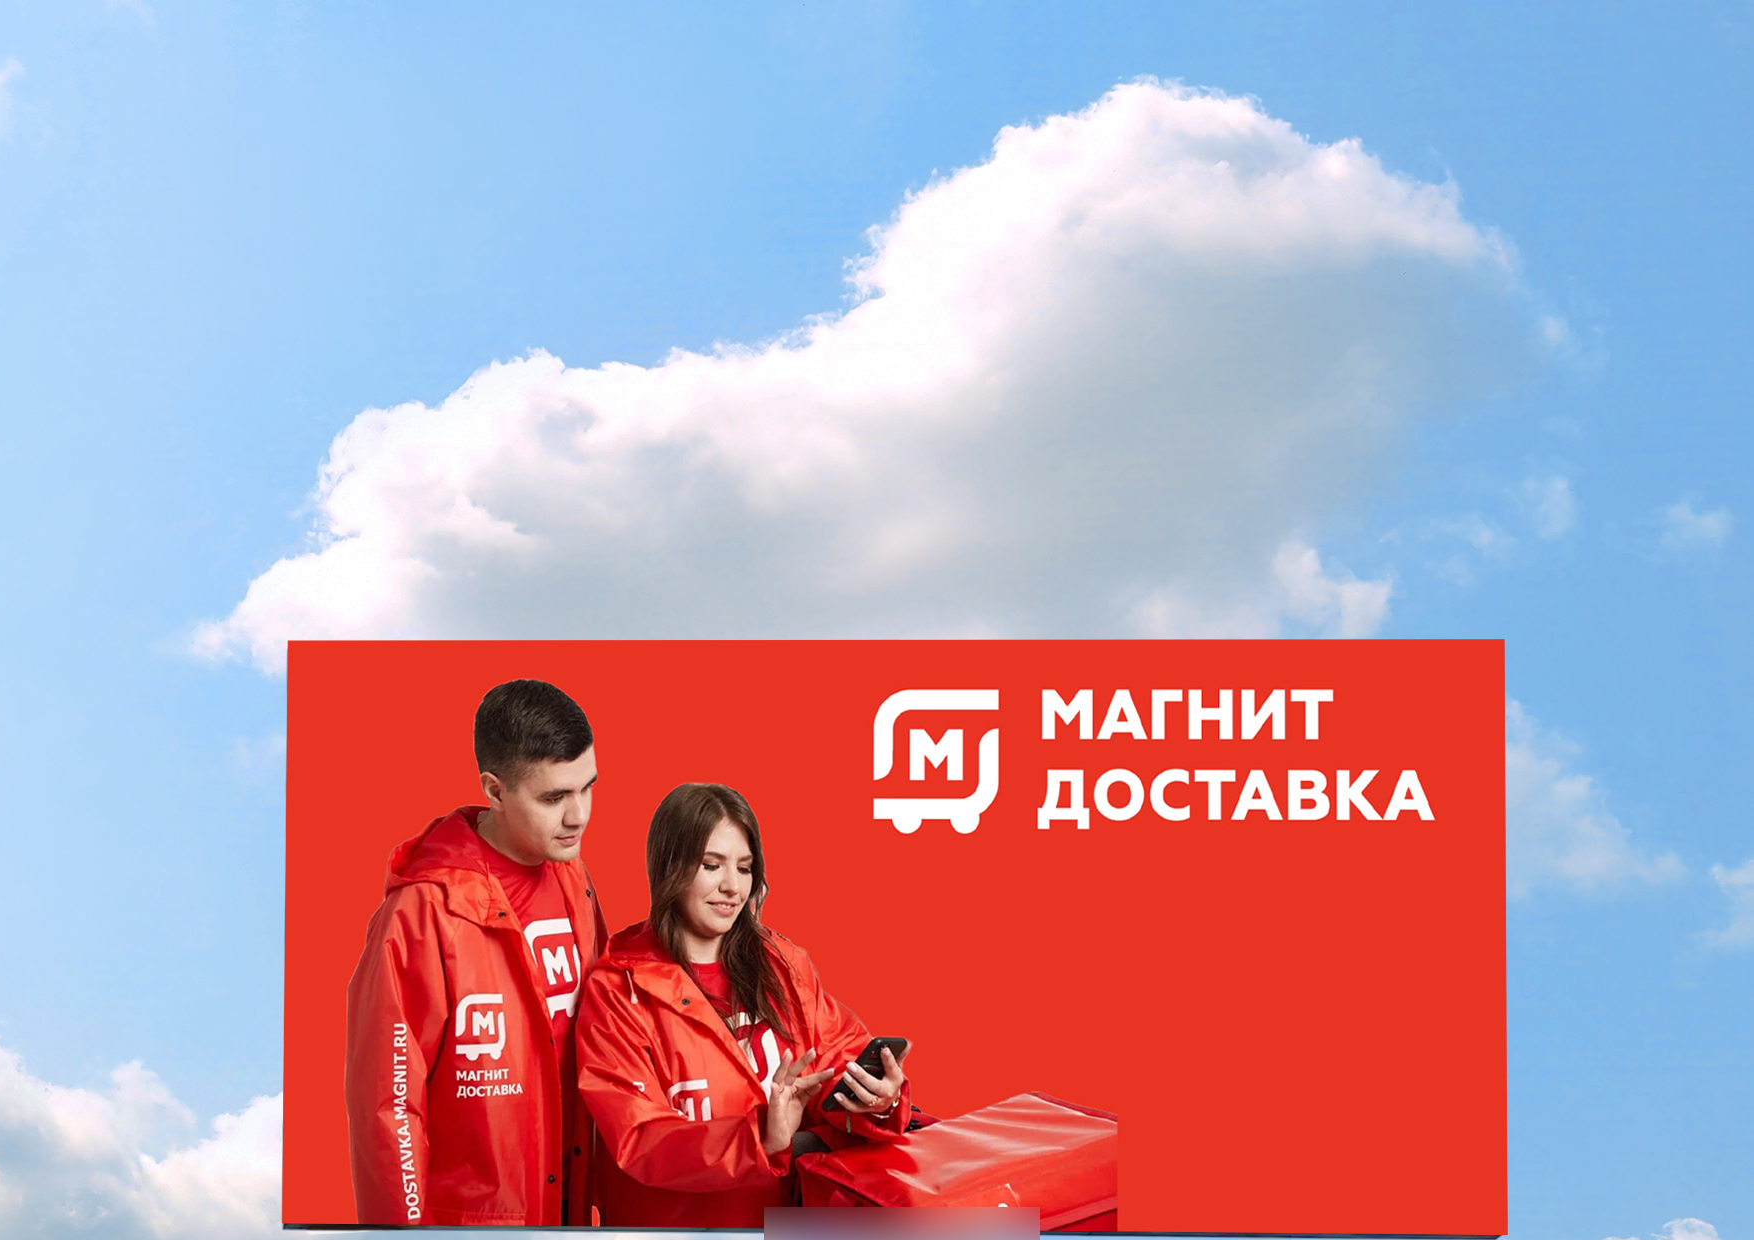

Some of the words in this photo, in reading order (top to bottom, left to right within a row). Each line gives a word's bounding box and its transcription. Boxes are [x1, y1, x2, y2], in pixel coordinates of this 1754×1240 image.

[1042, 689, 1334, 741] МАГНИТ
[1037, 768, 1436, 830] ДОСТАВКА
[456, 1067, 509, 1082] МАГНИТ
[456, 1083, 523, 1099] ДОСТАВКА
[393, 1022, 421, 1221] DOSTAVKA.MAGNIT.RU
